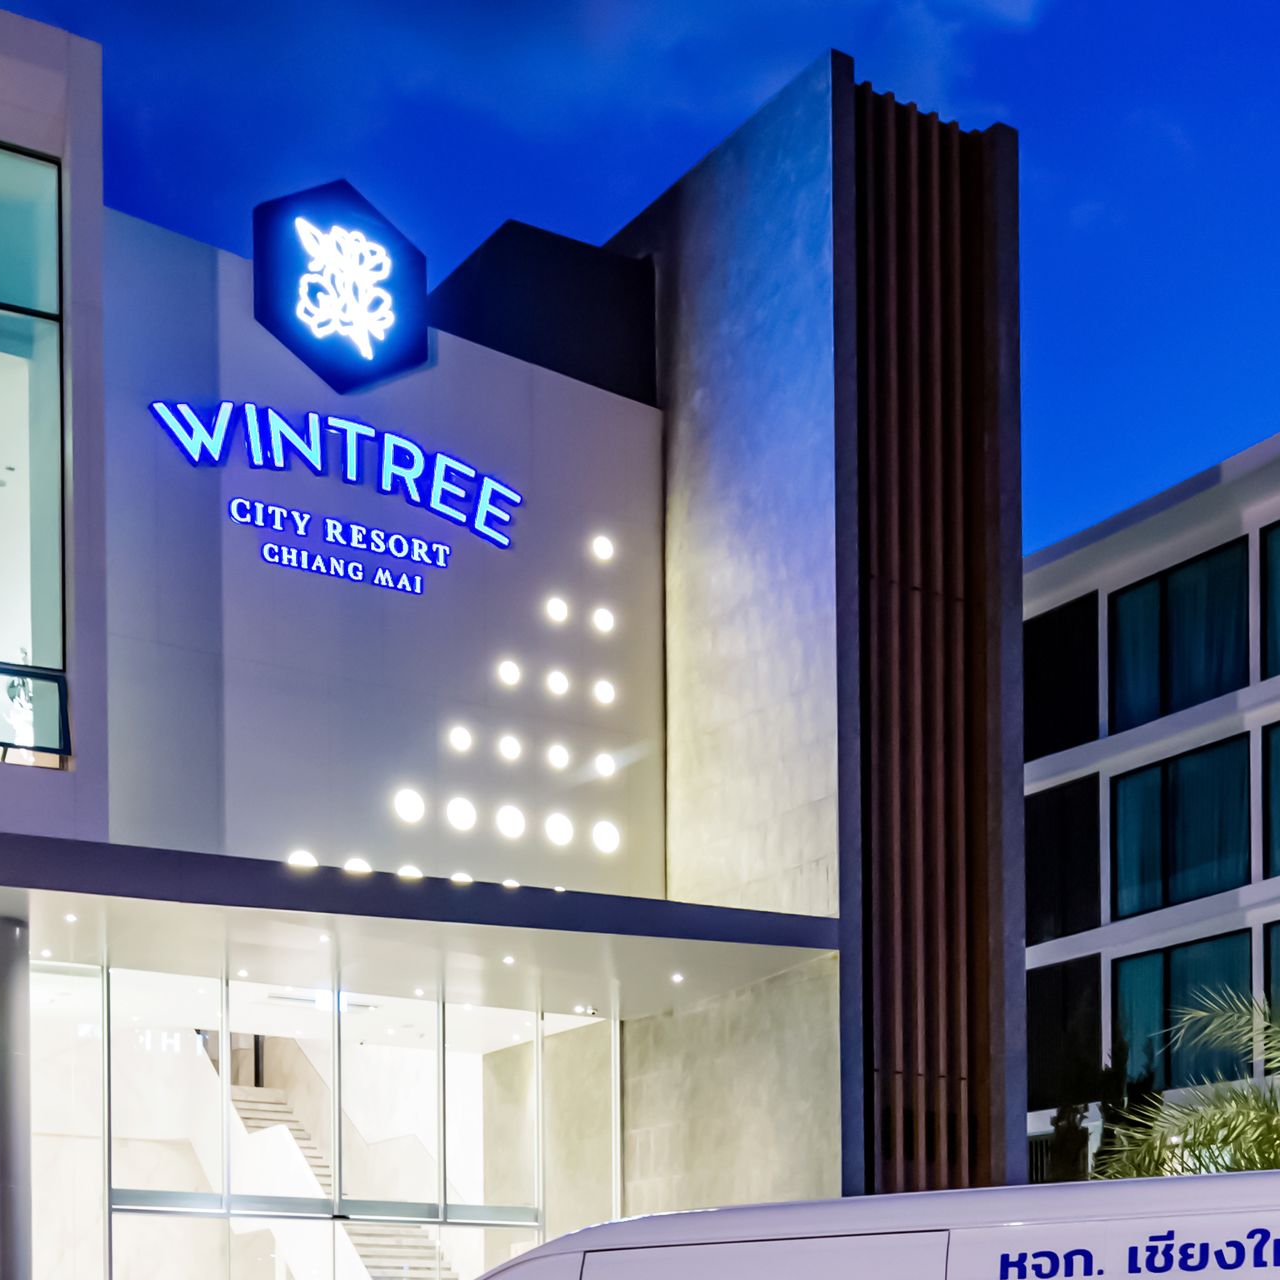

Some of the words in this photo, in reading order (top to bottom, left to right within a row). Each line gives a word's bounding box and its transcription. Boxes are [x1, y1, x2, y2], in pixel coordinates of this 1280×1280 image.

[150, 402, 522, 548] WINTREE
[228, 498, 312, 536] CITY
[325, 516, 451, 568] RESORT
[263, 543, 364, 581] CHIANG
[374, 567, 423, 594] MAI
[999, 1248, 1105, 1280] หจก.
